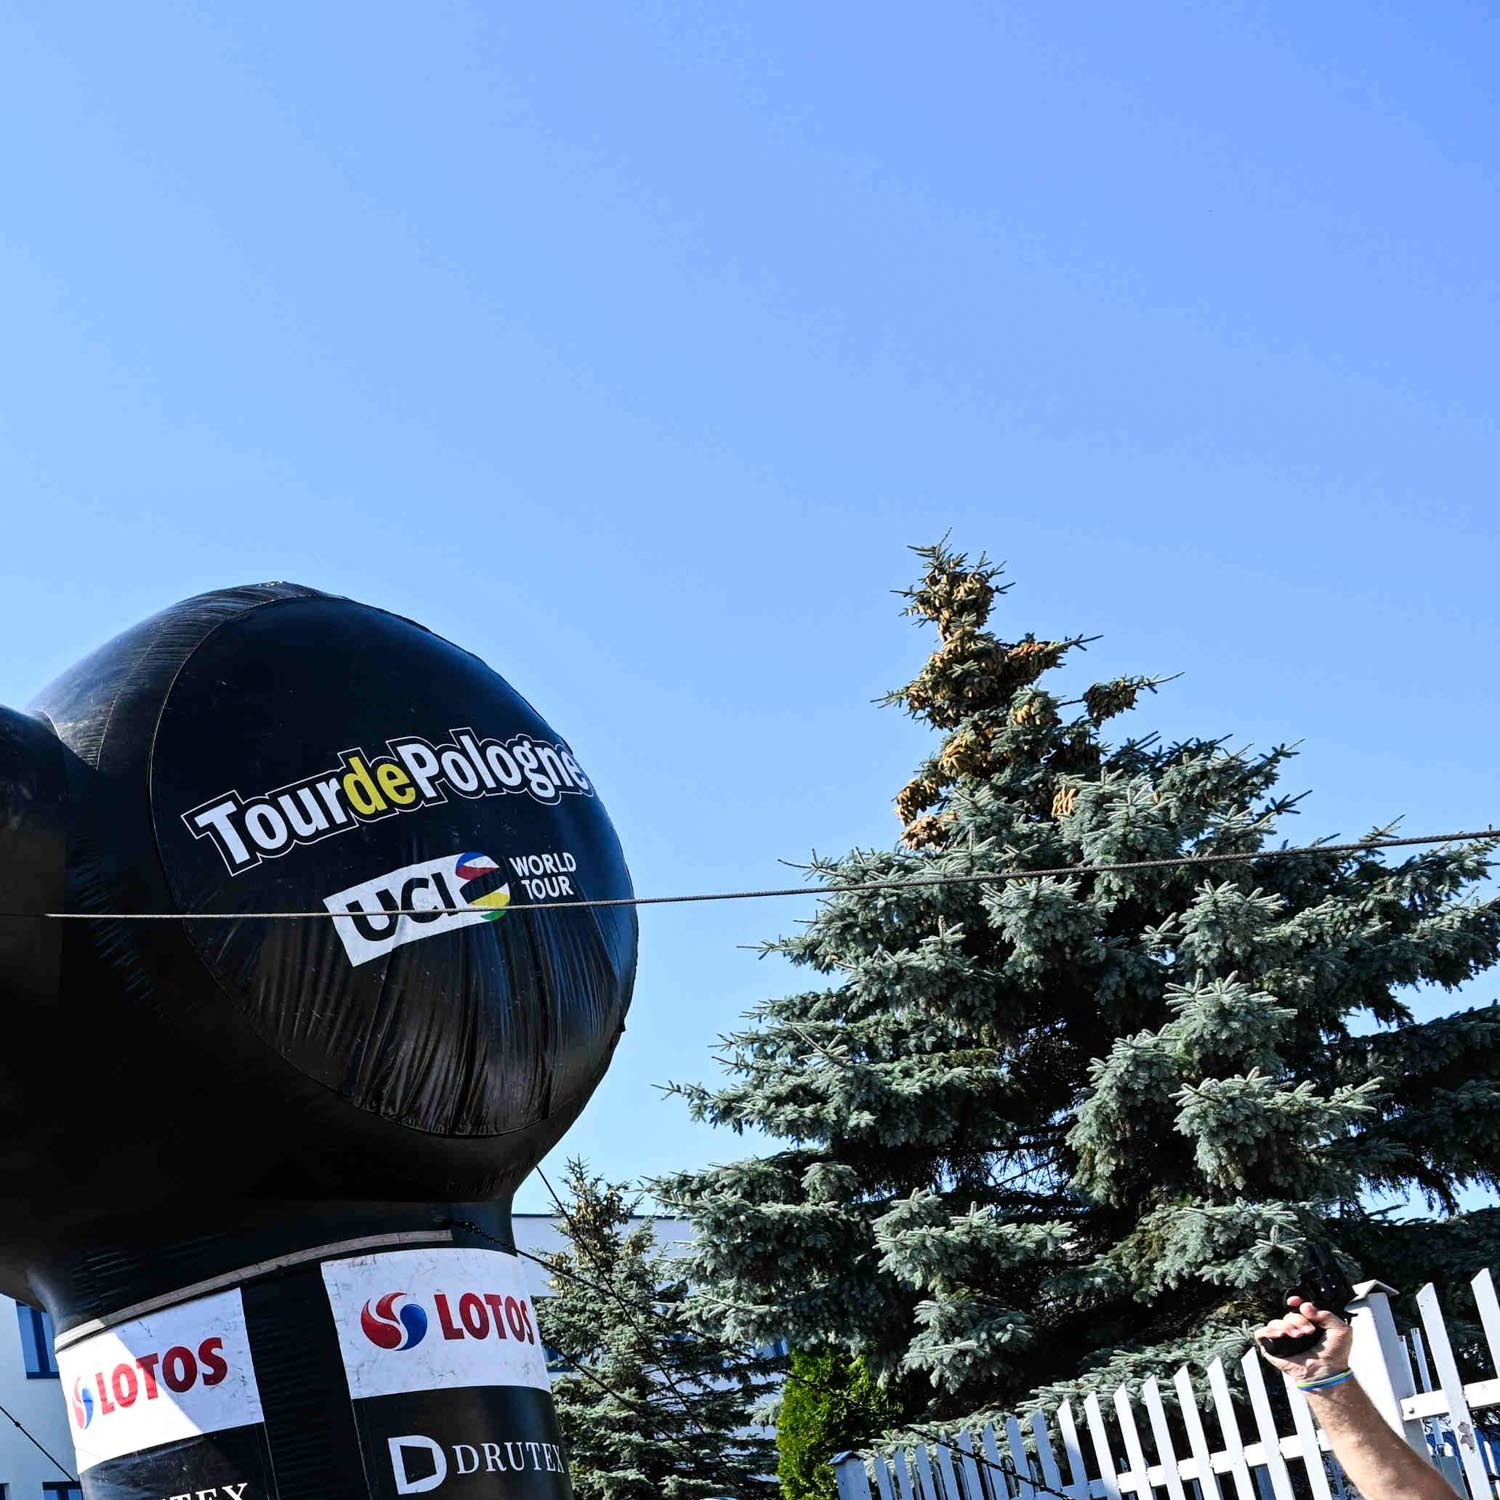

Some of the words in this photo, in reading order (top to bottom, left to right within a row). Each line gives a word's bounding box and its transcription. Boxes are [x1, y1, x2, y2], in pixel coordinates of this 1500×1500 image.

[345, 871, 456, 942] UCI
[509, 852, 577, 882] WORLD
[520, 875, 574, 900] TOUR
[433, 1291, 535, 1346] LOTOS
[96, 1337, 229, 1414] LOTOS
[456, 1439, 564, 1476] DRUTEX
